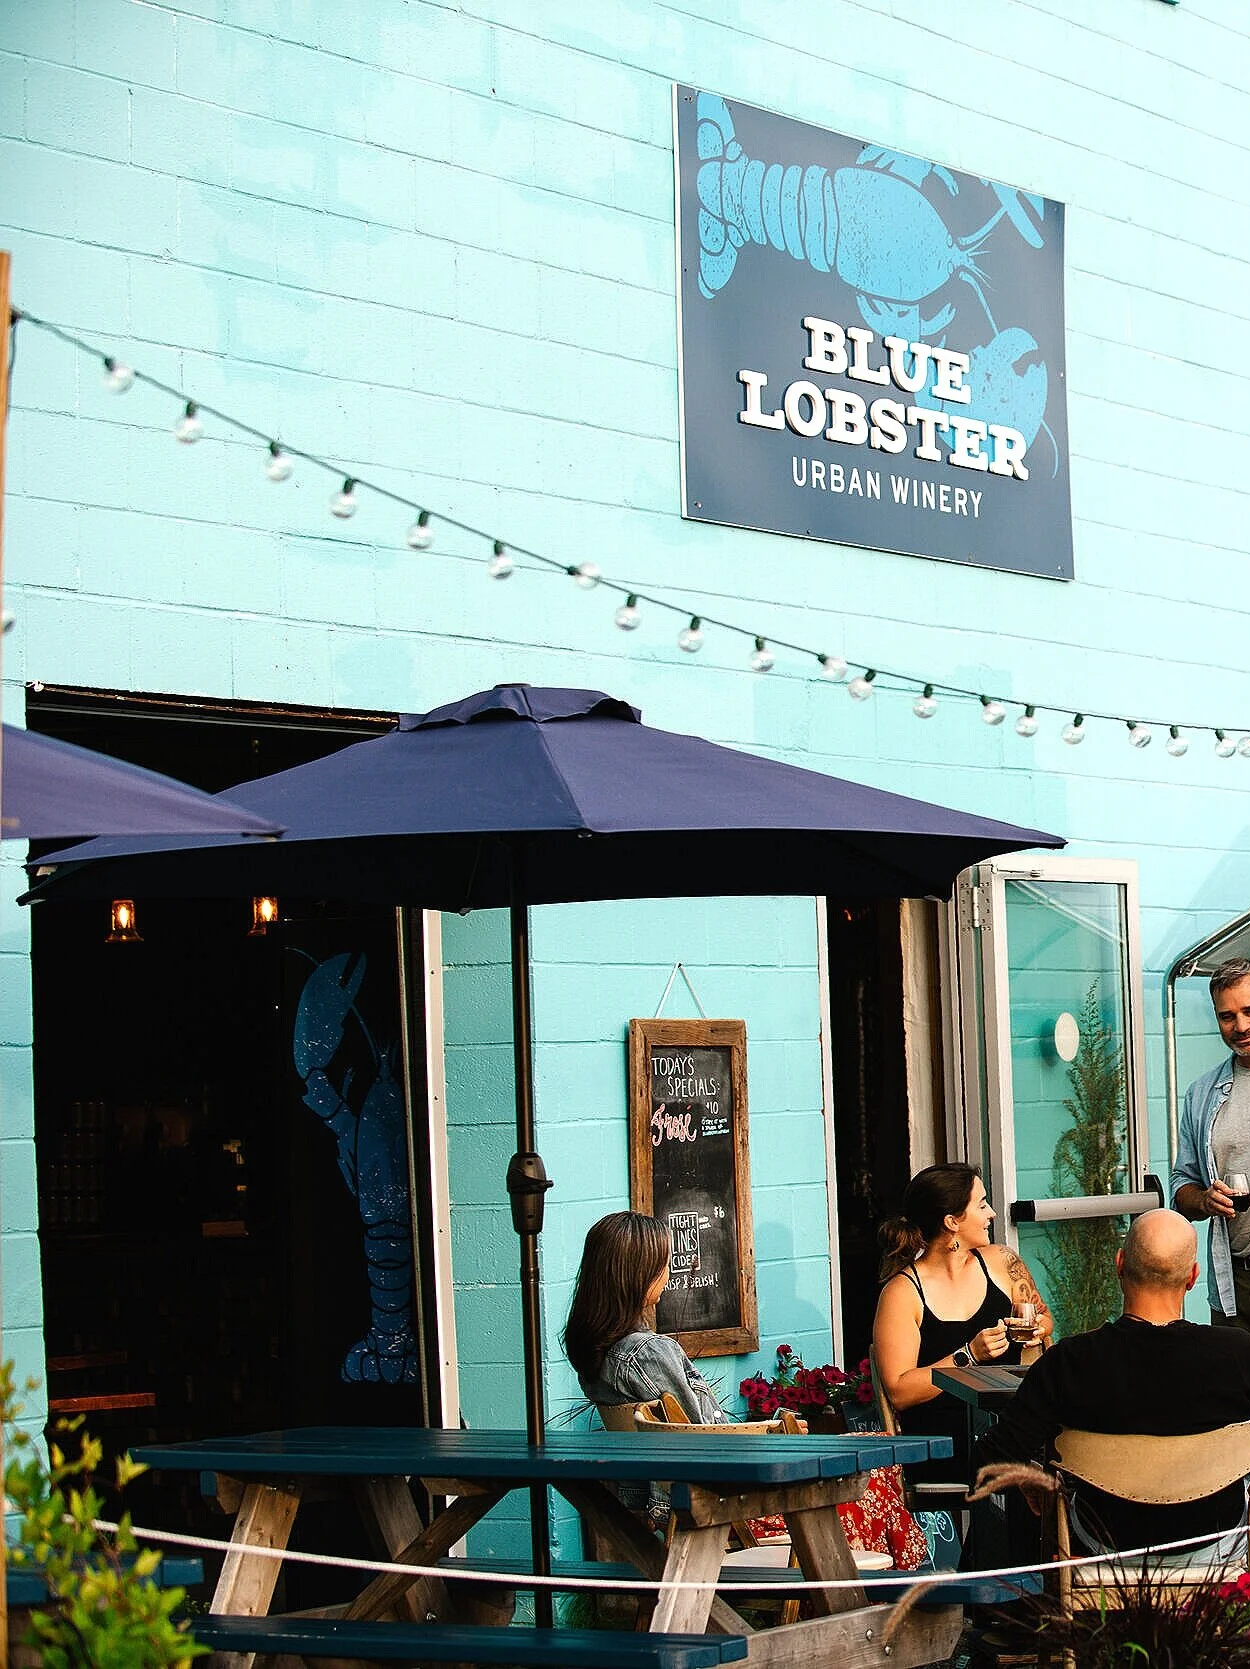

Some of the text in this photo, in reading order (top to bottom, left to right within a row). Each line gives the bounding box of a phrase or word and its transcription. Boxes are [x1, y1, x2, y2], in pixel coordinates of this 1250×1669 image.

[802, 316, 972, 406] BLUE
[736, 369, 1030, 481] LOBSTER
[792, 455, 984, 518] URBAN WINERY
[667, 1076, 720, 1098] SPECIALS:
[670, 1214, 696, 1229] TIGHT
[671, 1228, 698, 1255] LINES
[664, 1277, 681, 1292] RISP
